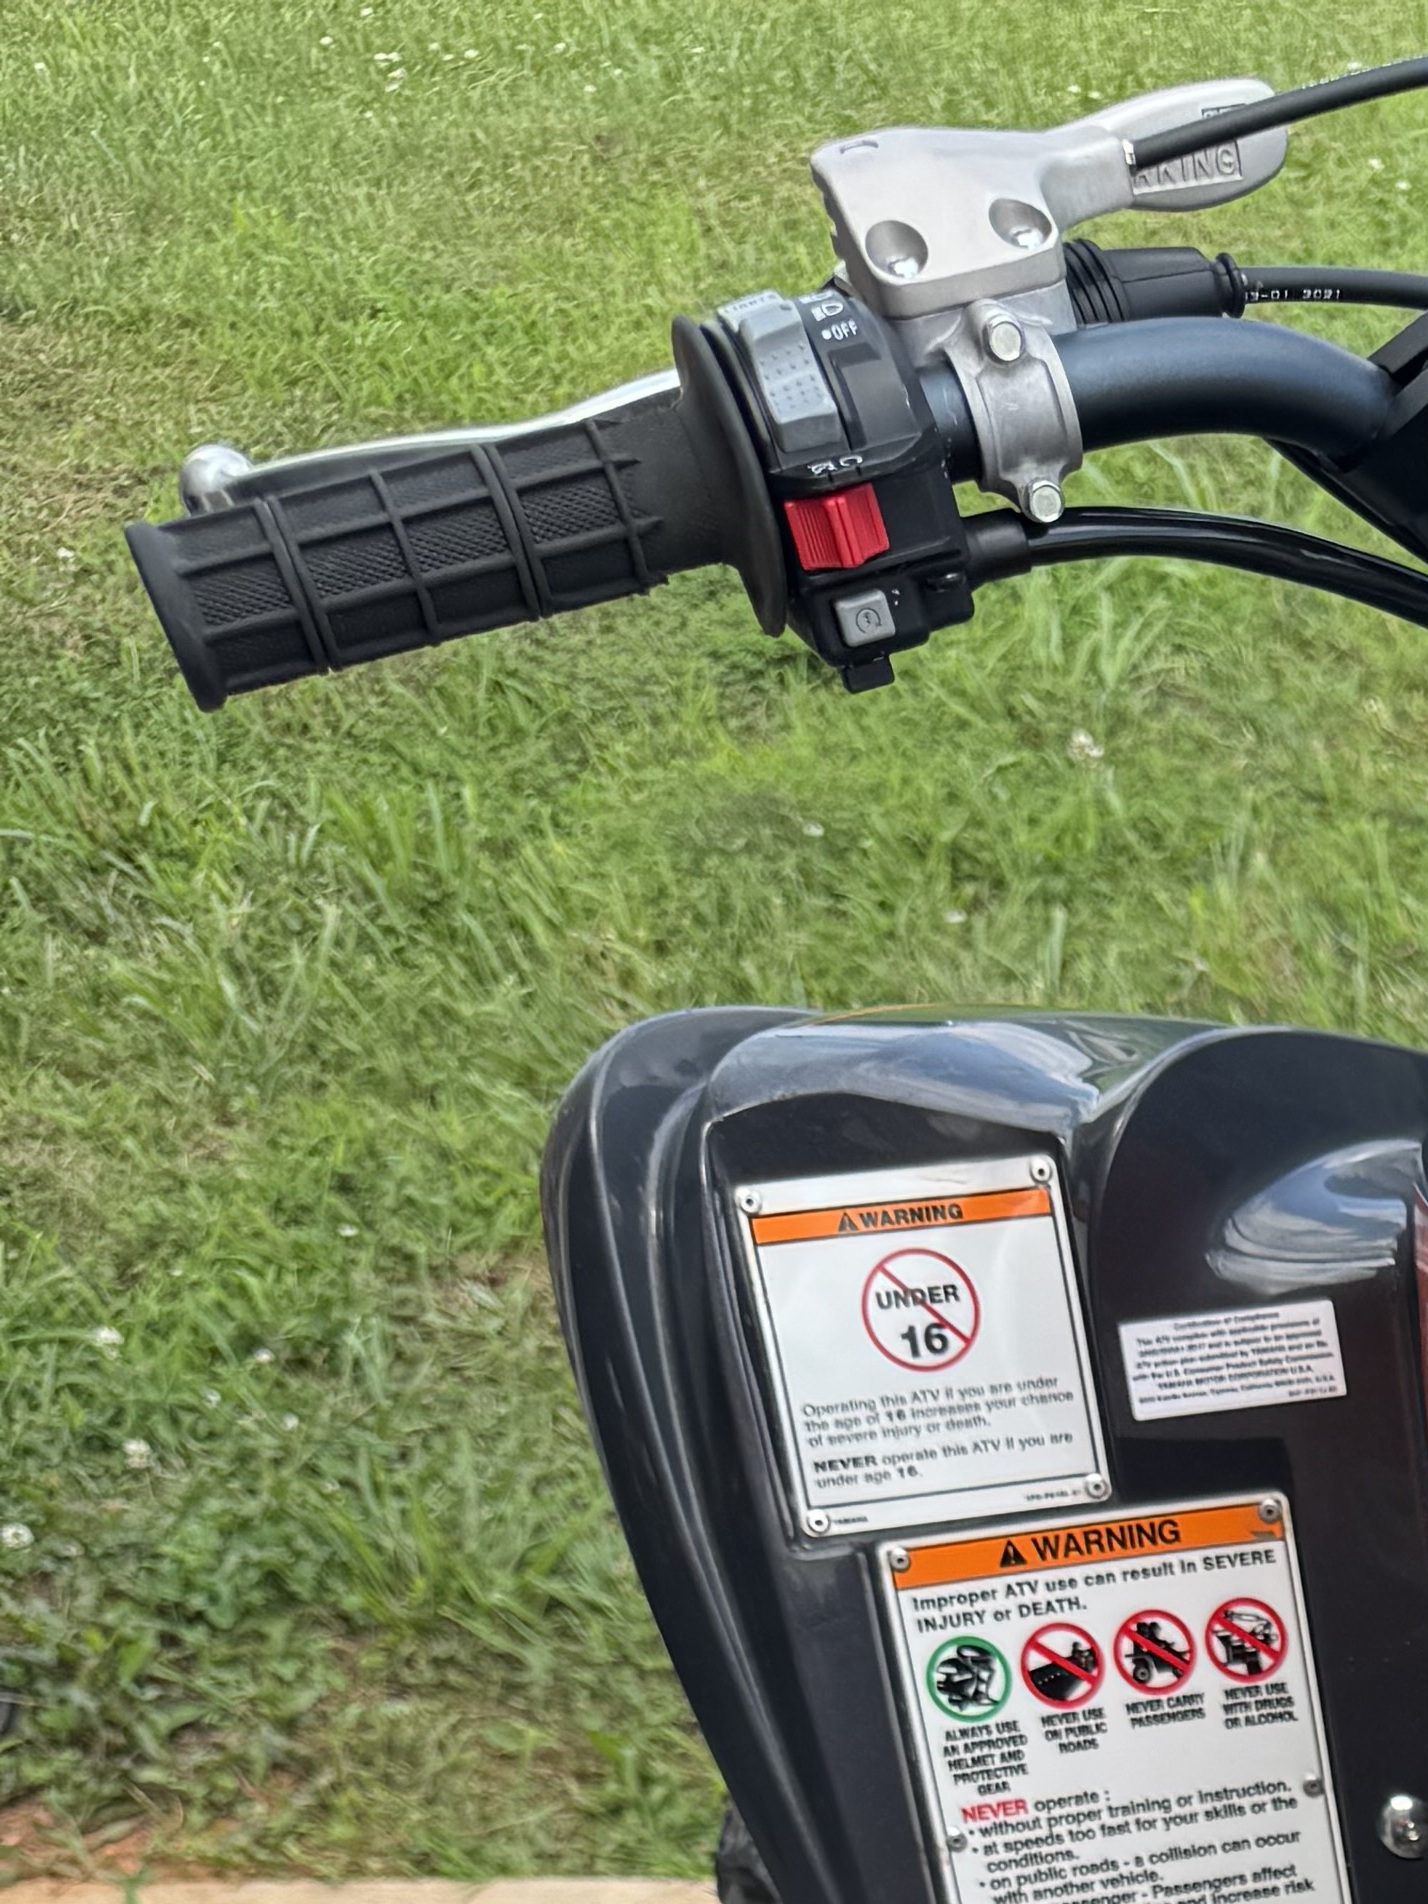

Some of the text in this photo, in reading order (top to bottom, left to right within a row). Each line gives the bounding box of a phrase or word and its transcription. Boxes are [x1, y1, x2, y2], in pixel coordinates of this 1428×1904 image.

[831, 320, 858, 340] OFF
[859, 1203, 963, 1228] WARNING
[876, 1284, 960, 1309] UNDER
[901, 1320, 949, 1358] 16
[1031, 1519, 1181, 1562] WARNING
[912, 1549, 1276, 1611] Improper ATV use can result in SEVERE
[917, 1596, 1087, 1633] INJURY or DEATH.
